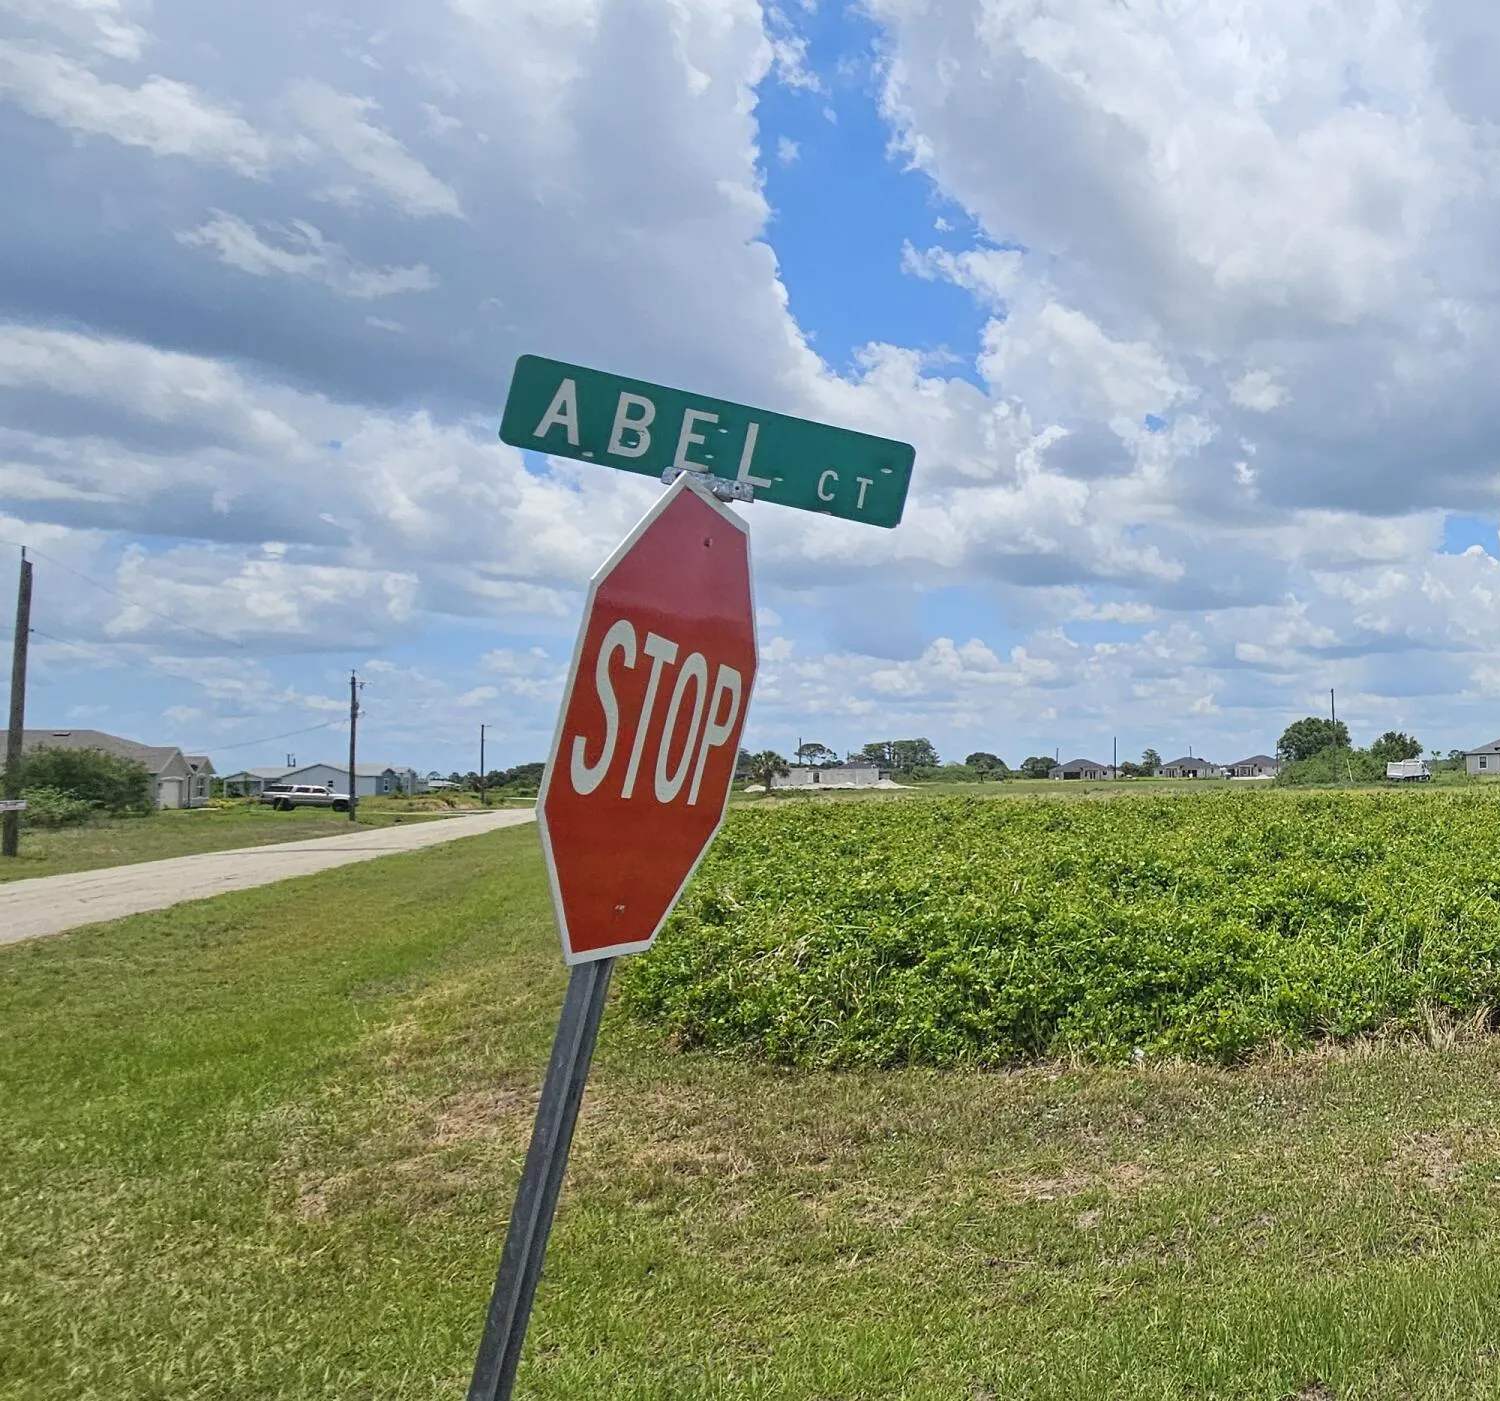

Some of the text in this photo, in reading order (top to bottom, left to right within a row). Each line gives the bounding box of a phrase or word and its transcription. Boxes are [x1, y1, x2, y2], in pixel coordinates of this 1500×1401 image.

[533, 378, 874, 509] ABEL CT
[570, 620, 742, 805] STOP
